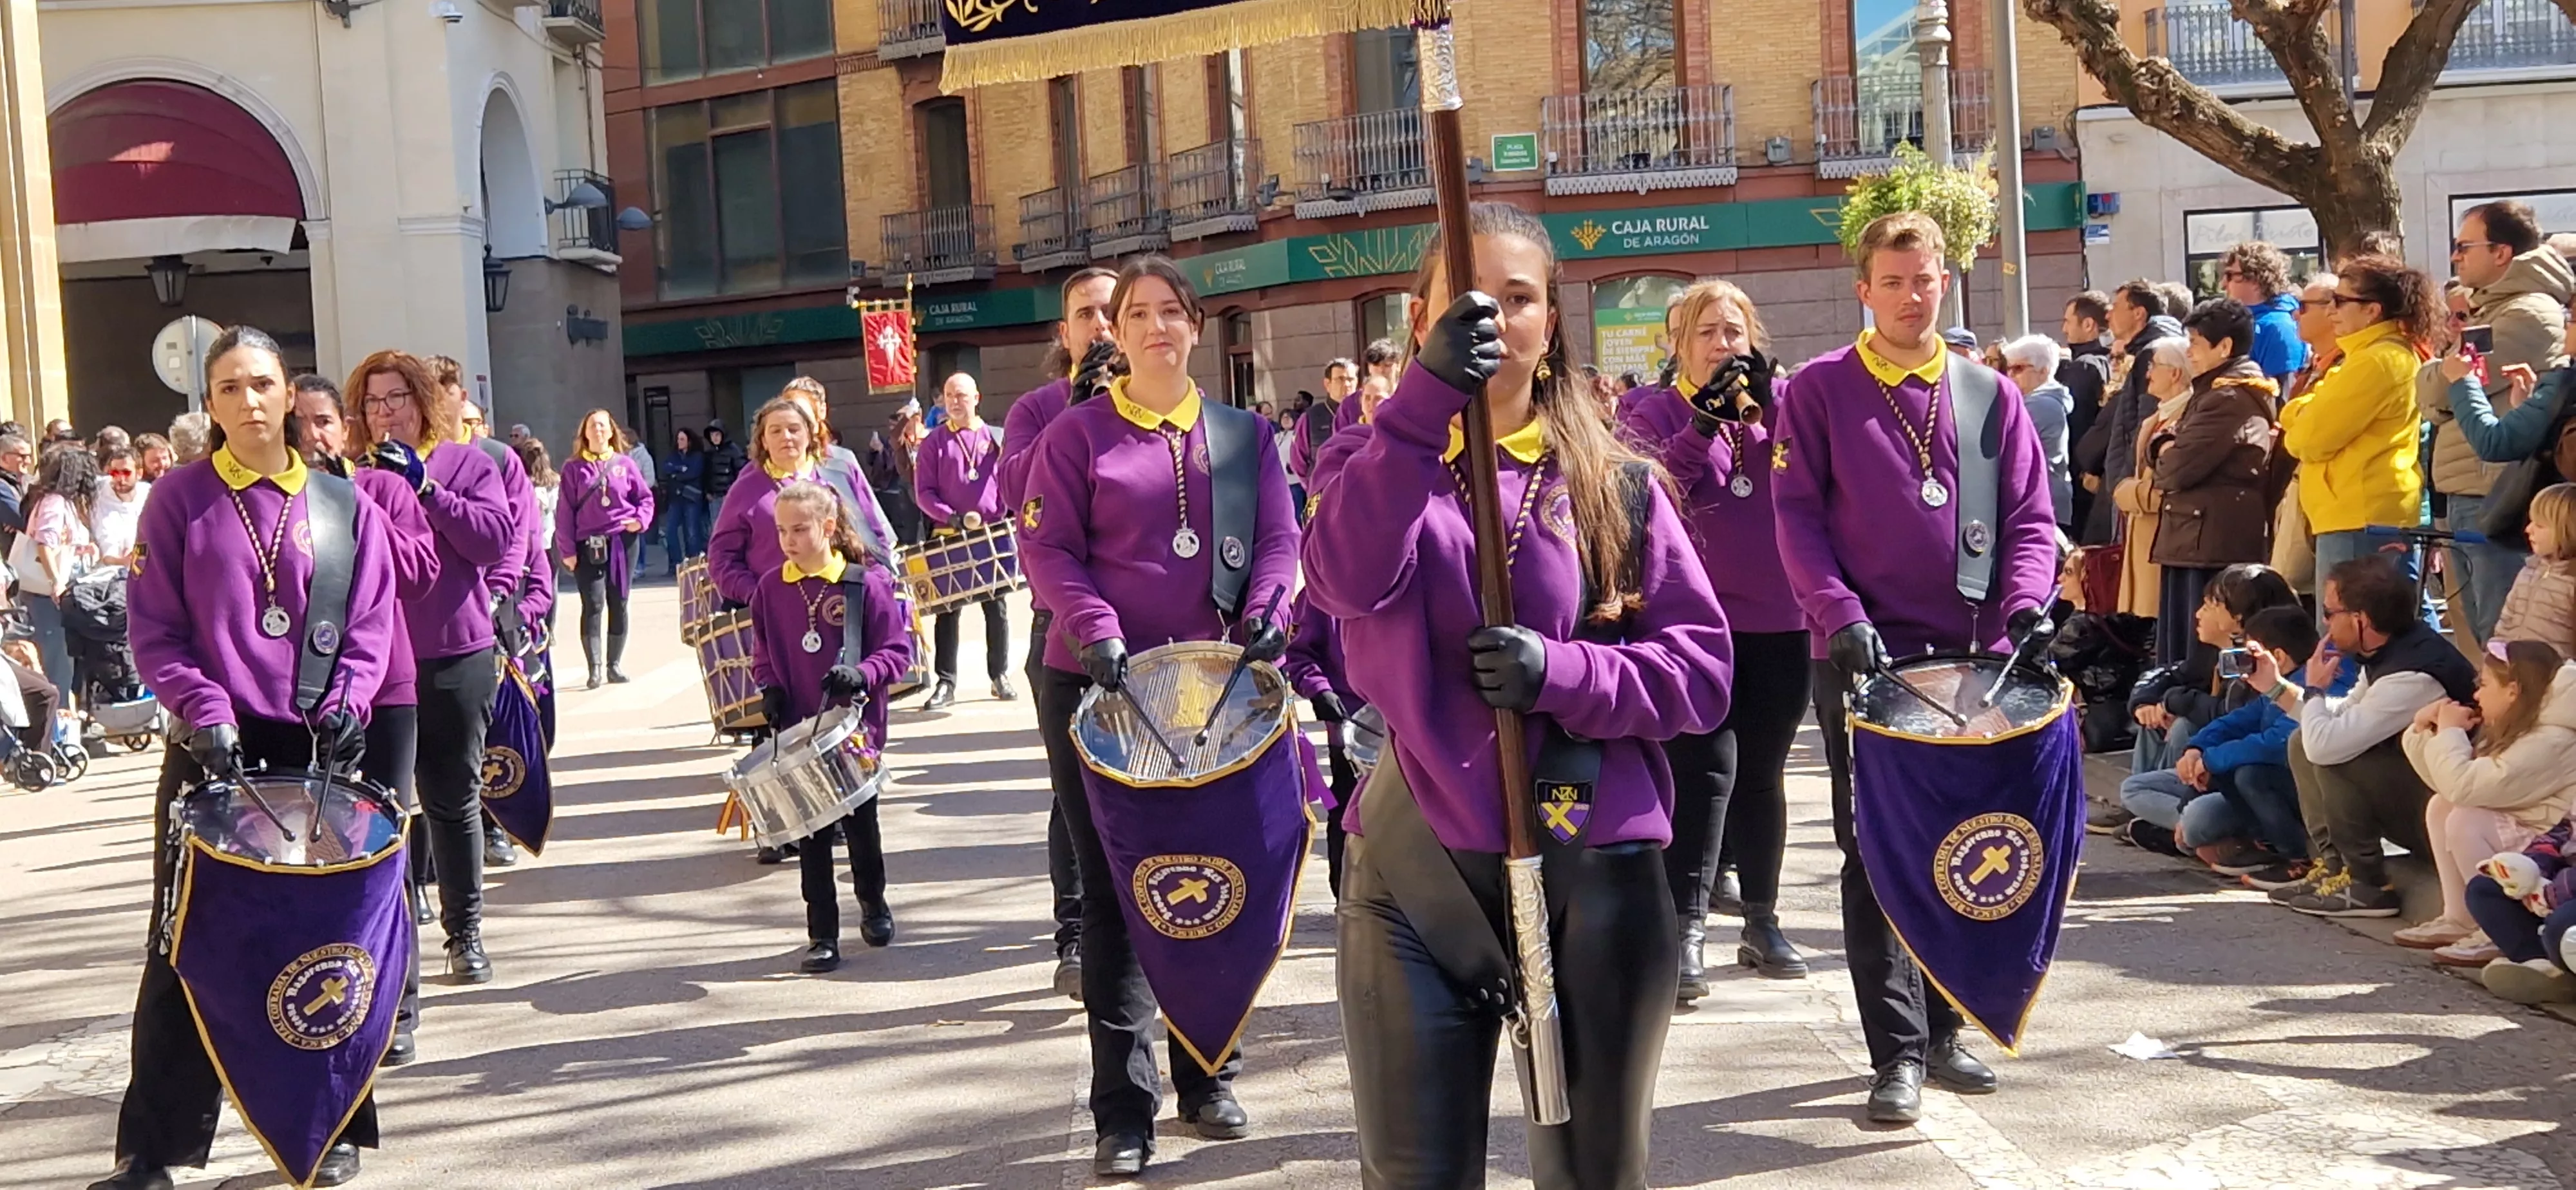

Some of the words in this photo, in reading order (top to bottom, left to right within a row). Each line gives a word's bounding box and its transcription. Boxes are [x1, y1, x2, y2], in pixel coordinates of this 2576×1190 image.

[1611, 219, 1653, 234] CAJA
[1656, 215, 1710, 232] RURAL
[1623, 238, 1640, 249] DE
[1643, 232, 1700, 247] ARAGÓN
